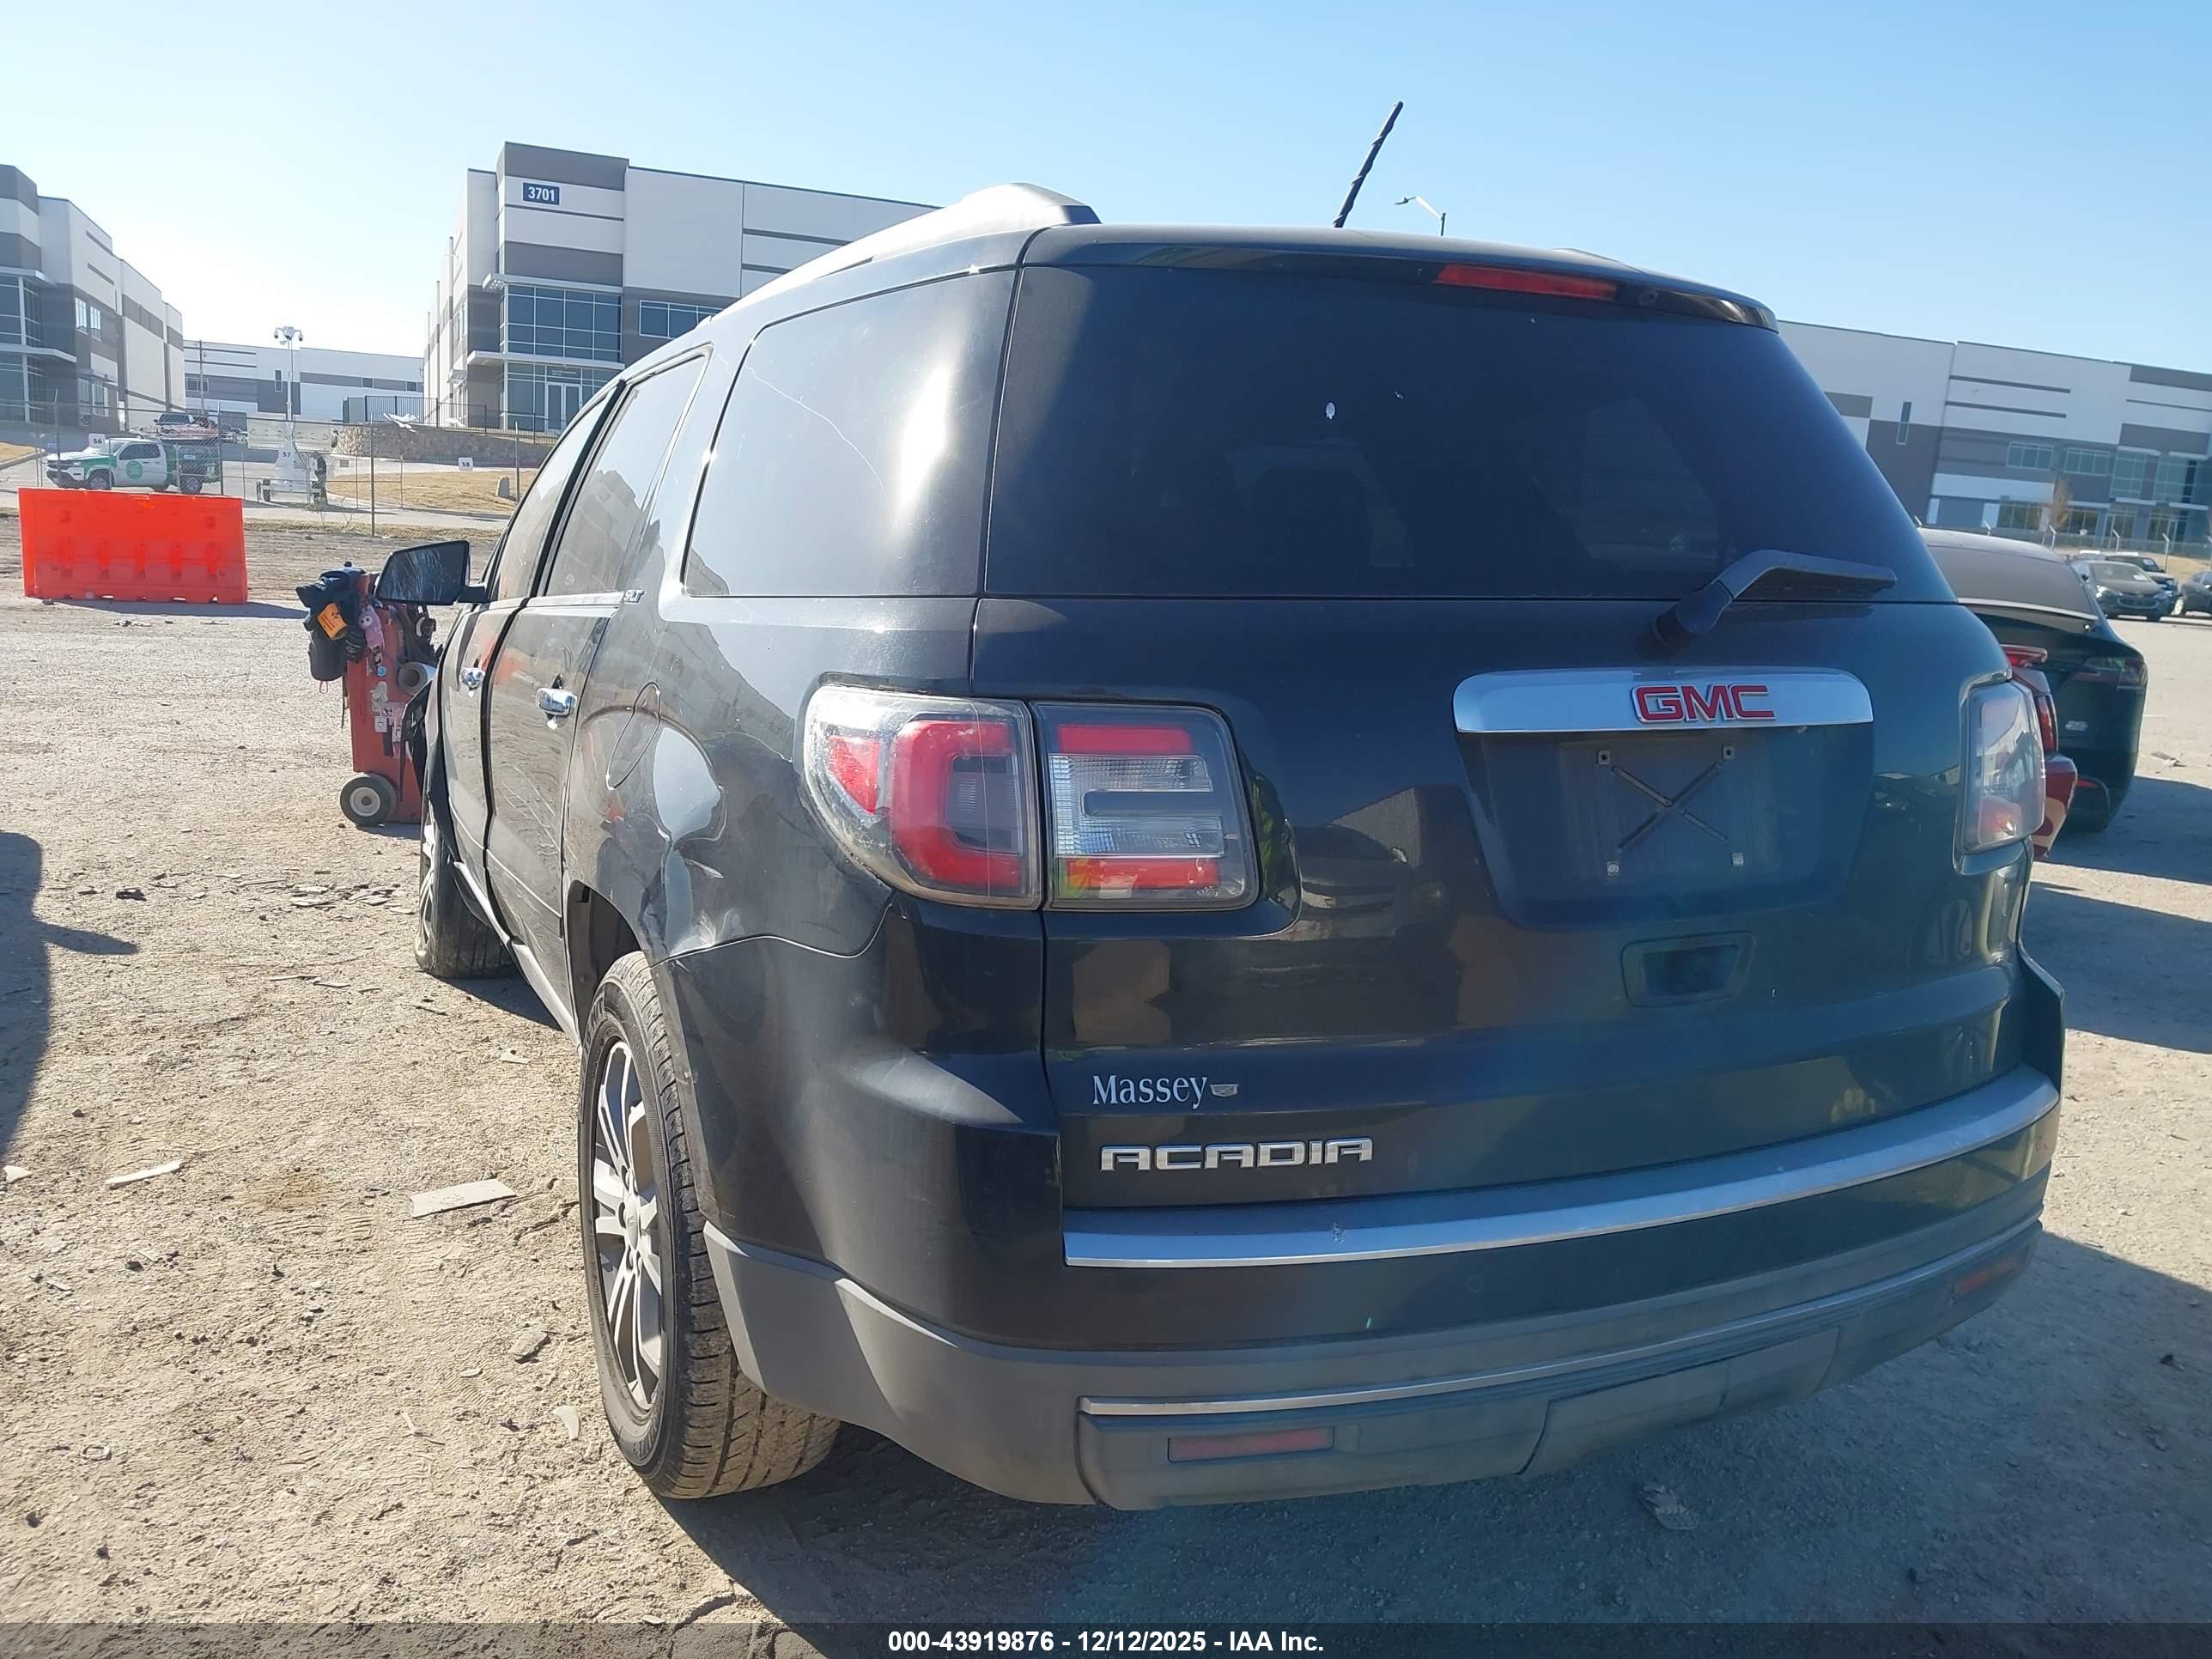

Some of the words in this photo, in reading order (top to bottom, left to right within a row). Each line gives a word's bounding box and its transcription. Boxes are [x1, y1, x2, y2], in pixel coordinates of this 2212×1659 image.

[528, 186, 555, 202] 3701
[624, 589, 646, 603] SLT
[1632, 684, 1775, 722] GMC
[1093, 1075, 1207, 1109] Massey
[1101, 1138, 1373, 1170] ACADIA
